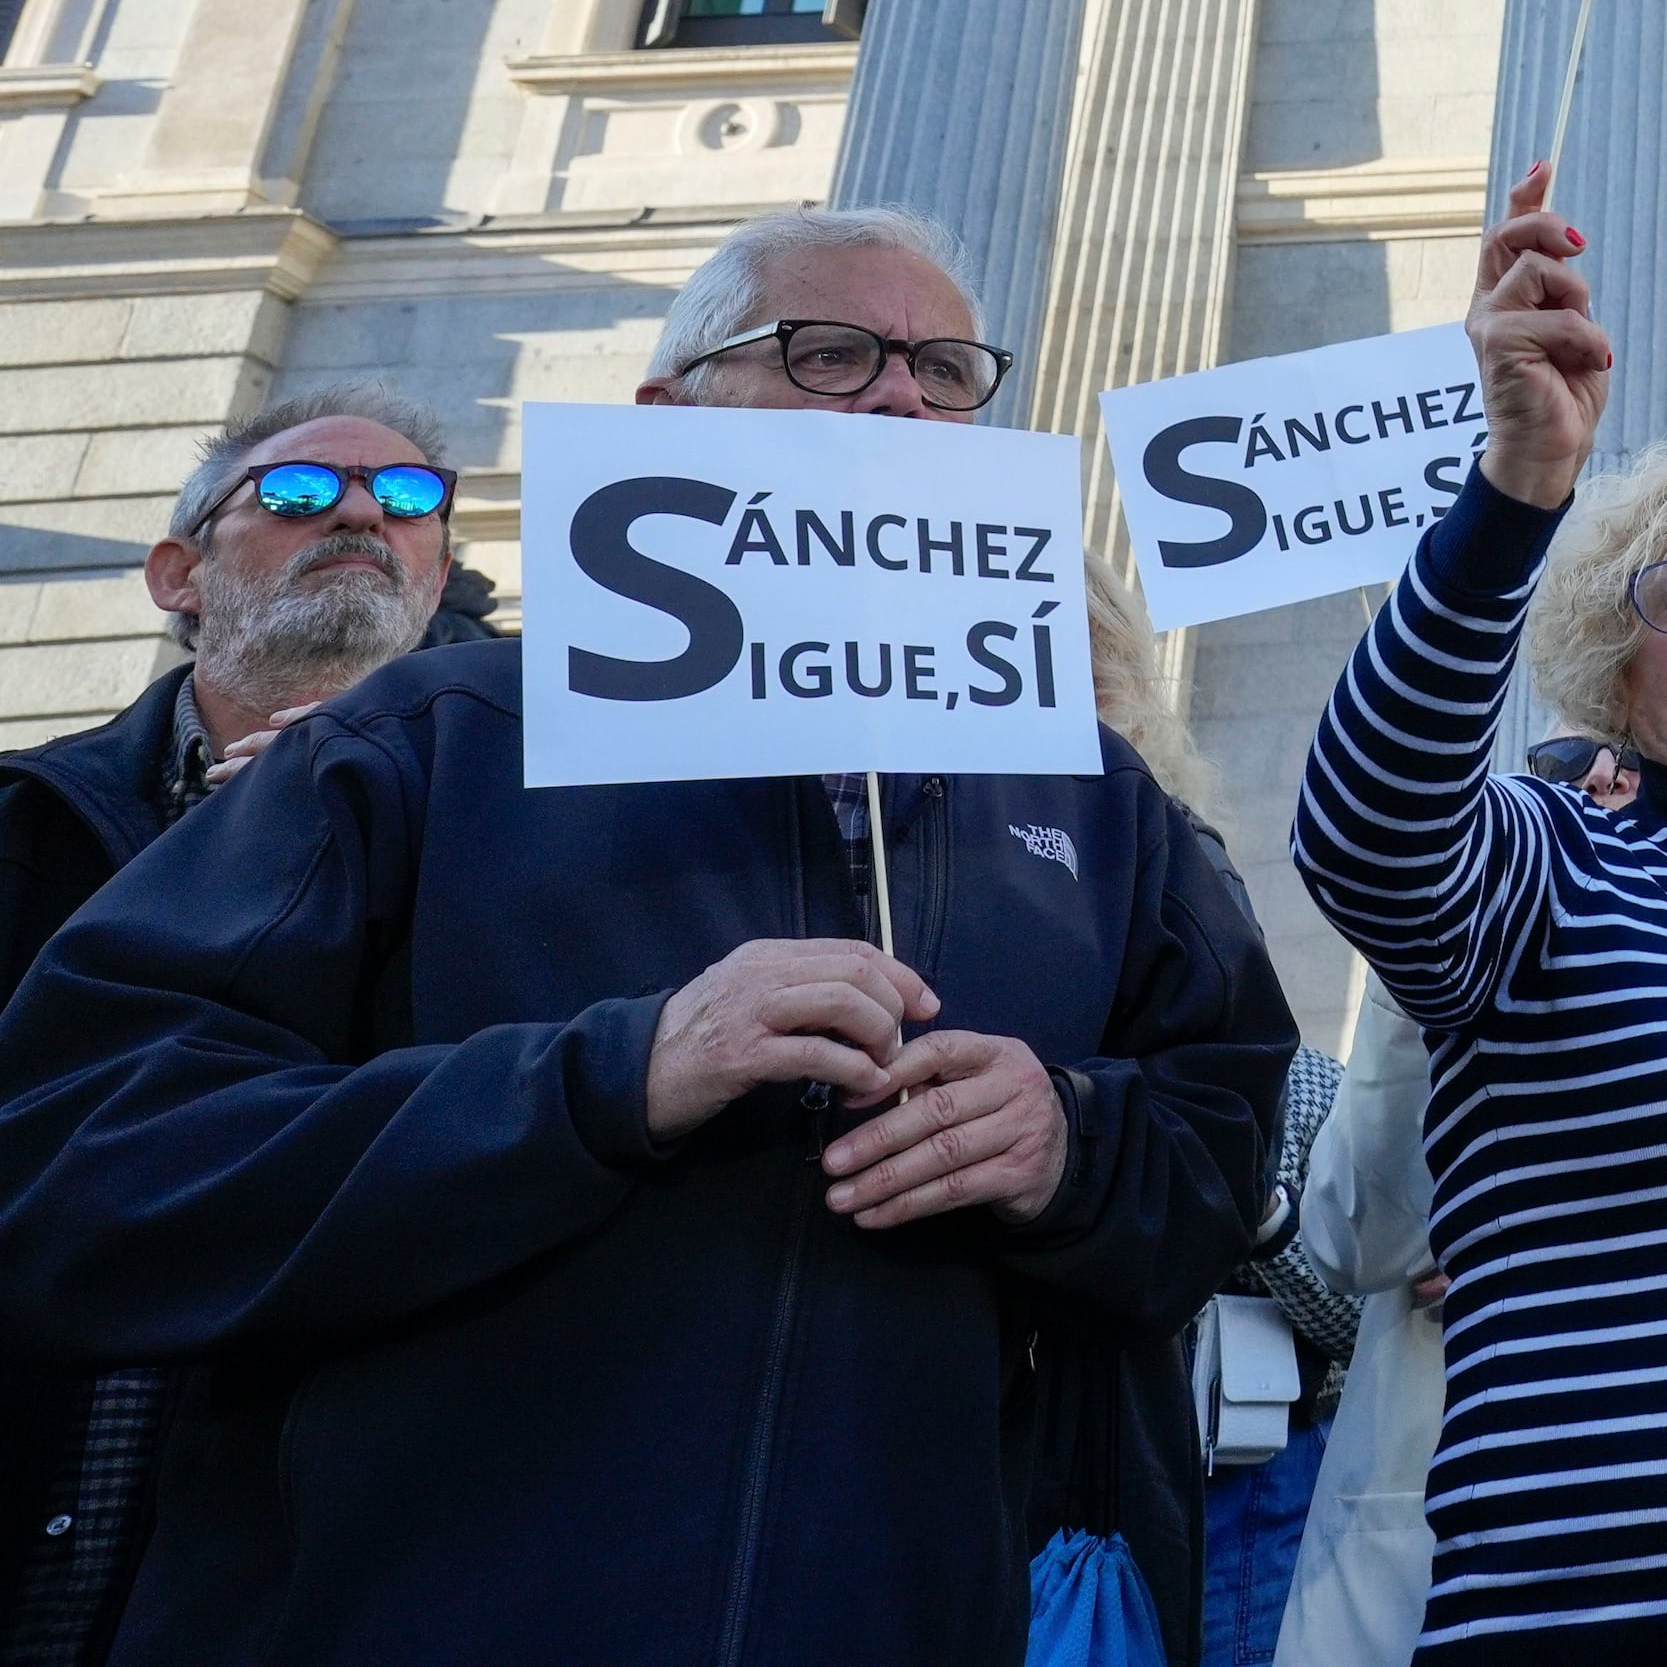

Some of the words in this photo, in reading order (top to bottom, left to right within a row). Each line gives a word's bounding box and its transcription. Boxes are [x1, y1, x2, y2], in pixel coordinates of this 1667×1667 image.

[1008, 824, 1064, 852] NORTH
[1026, 823, 1062, 840] THE
[1026, 841, 1066, 864] FACE
